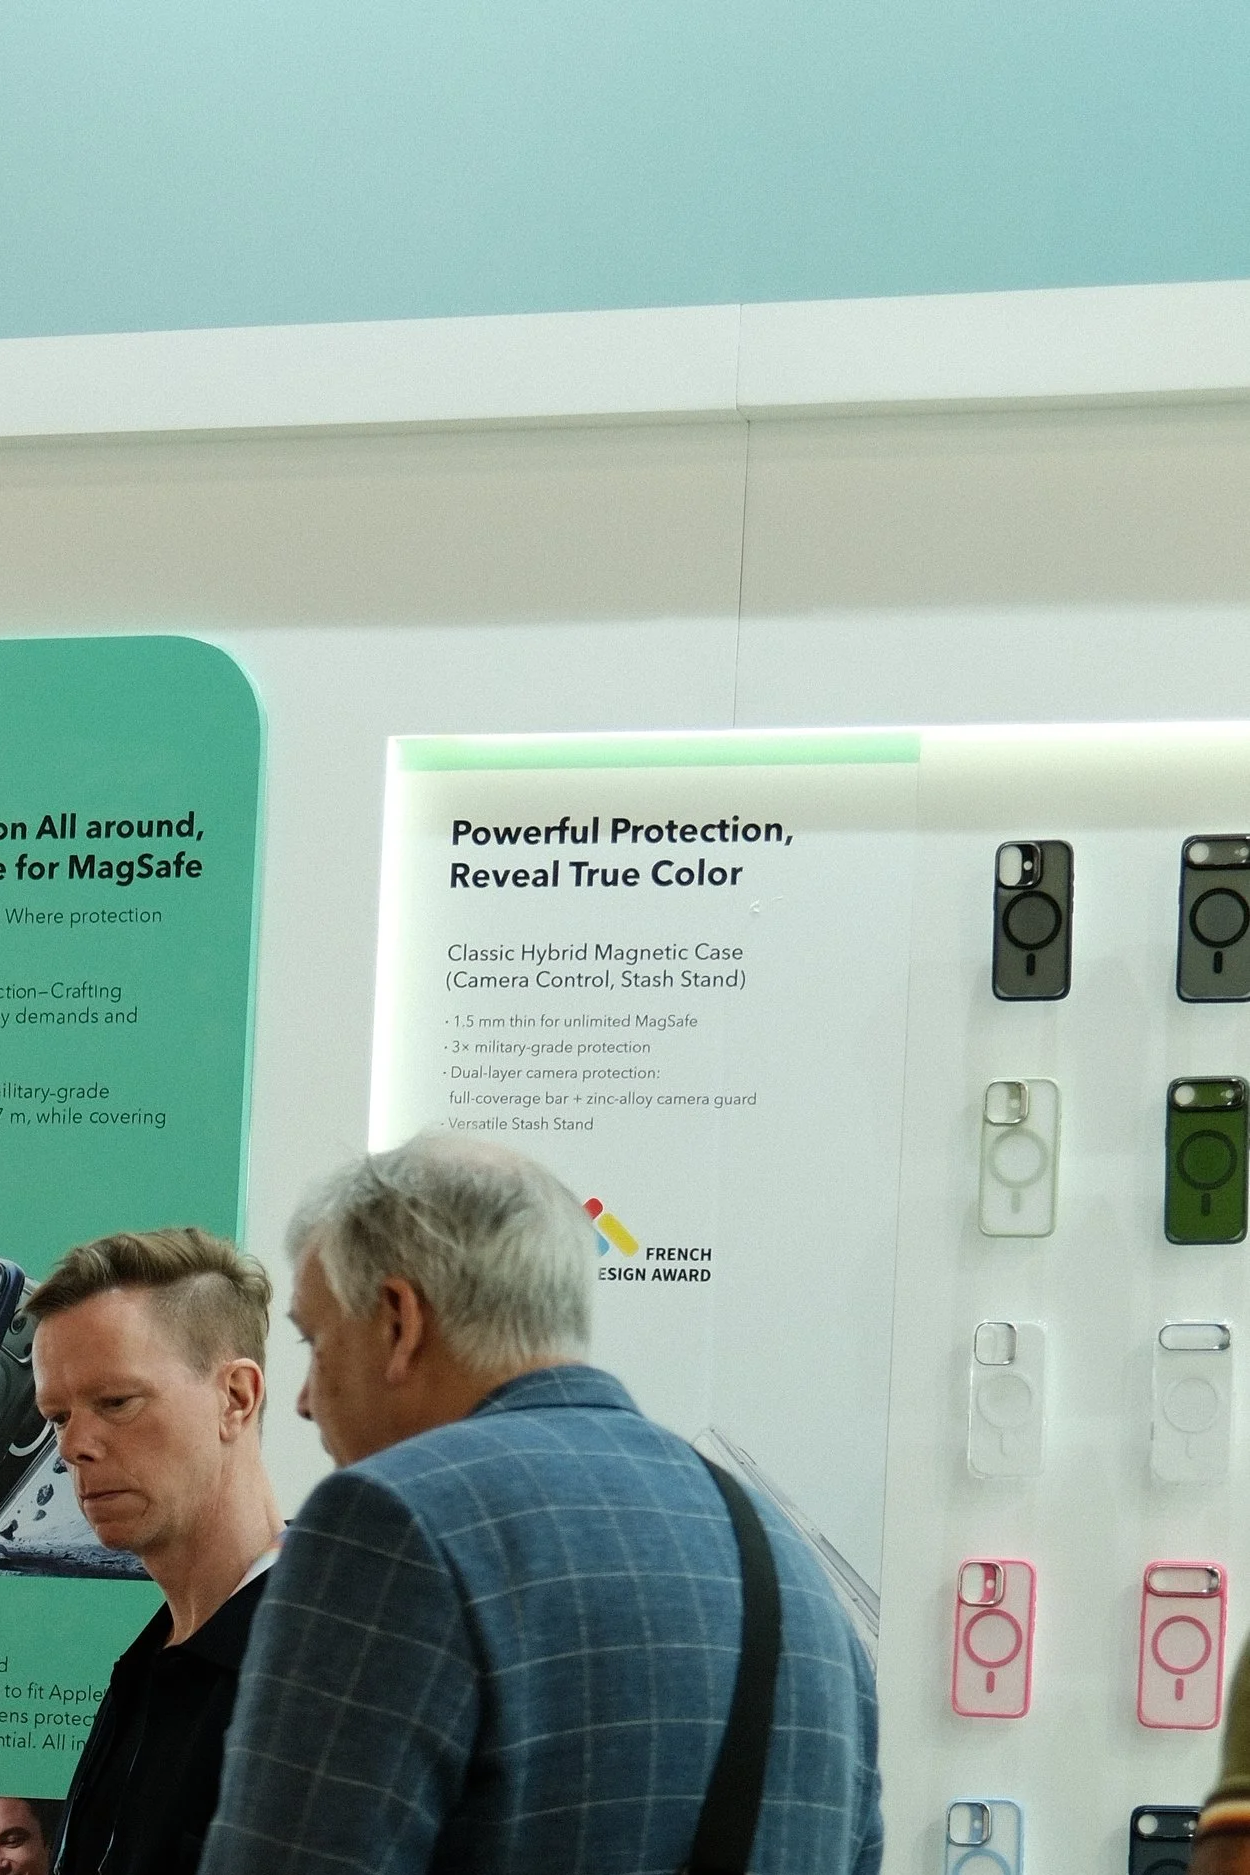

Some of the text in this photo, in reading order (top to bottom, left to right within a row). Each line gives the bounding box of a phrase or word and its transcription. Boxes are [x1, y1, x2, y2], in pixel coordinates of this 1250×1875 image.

[36, 813, 76, 839] All
[86, 811, 203, 841] around,
[453, 815, 792, 845] Powerful Protection,
[15, 854, 59, 880] for
[69, 851, 202, 886] MagSafe
[451, 859, 743, 888] Reveal True Color
[6, 907, 63, 924] Where
[71, 909, 161, 928] protection
[448, 943, 743, 966] Classic Hybrid Magnetic Case
[447, 969, 745, 991] (Camera Control, Stash Stand)
[16, 1007, 98, 1024] demands
[105, 1006, 137, 1023] and
[455, 1014, 697, 1031] 1.5 mm thin for unlimited MagSafe
[475, 1040, 572, 1056] military-grade
[578, 1043, 650, 1056] protection
[451, 1065, 660, 1082] Dual-layer camera protection:
[450, 1091, 756, 1108] full-coverage bar + zinc-alloy camera guard
[11, 1113, 31, 1125] m,
[37, 1107, 82, 1124] while
[90, 1108, 165, 1129] covering
[449, 1117, 593, 1130] Versatile Stash Stand
[647, 1248, 711, 1261] FRENCH
[599, 1268, 711, 1281] ESIGN AWARD
[5, 1685, 21, 1698] to
[28, 1682, 44, 1699] fit
[42, 1733, 65, 1750] All
